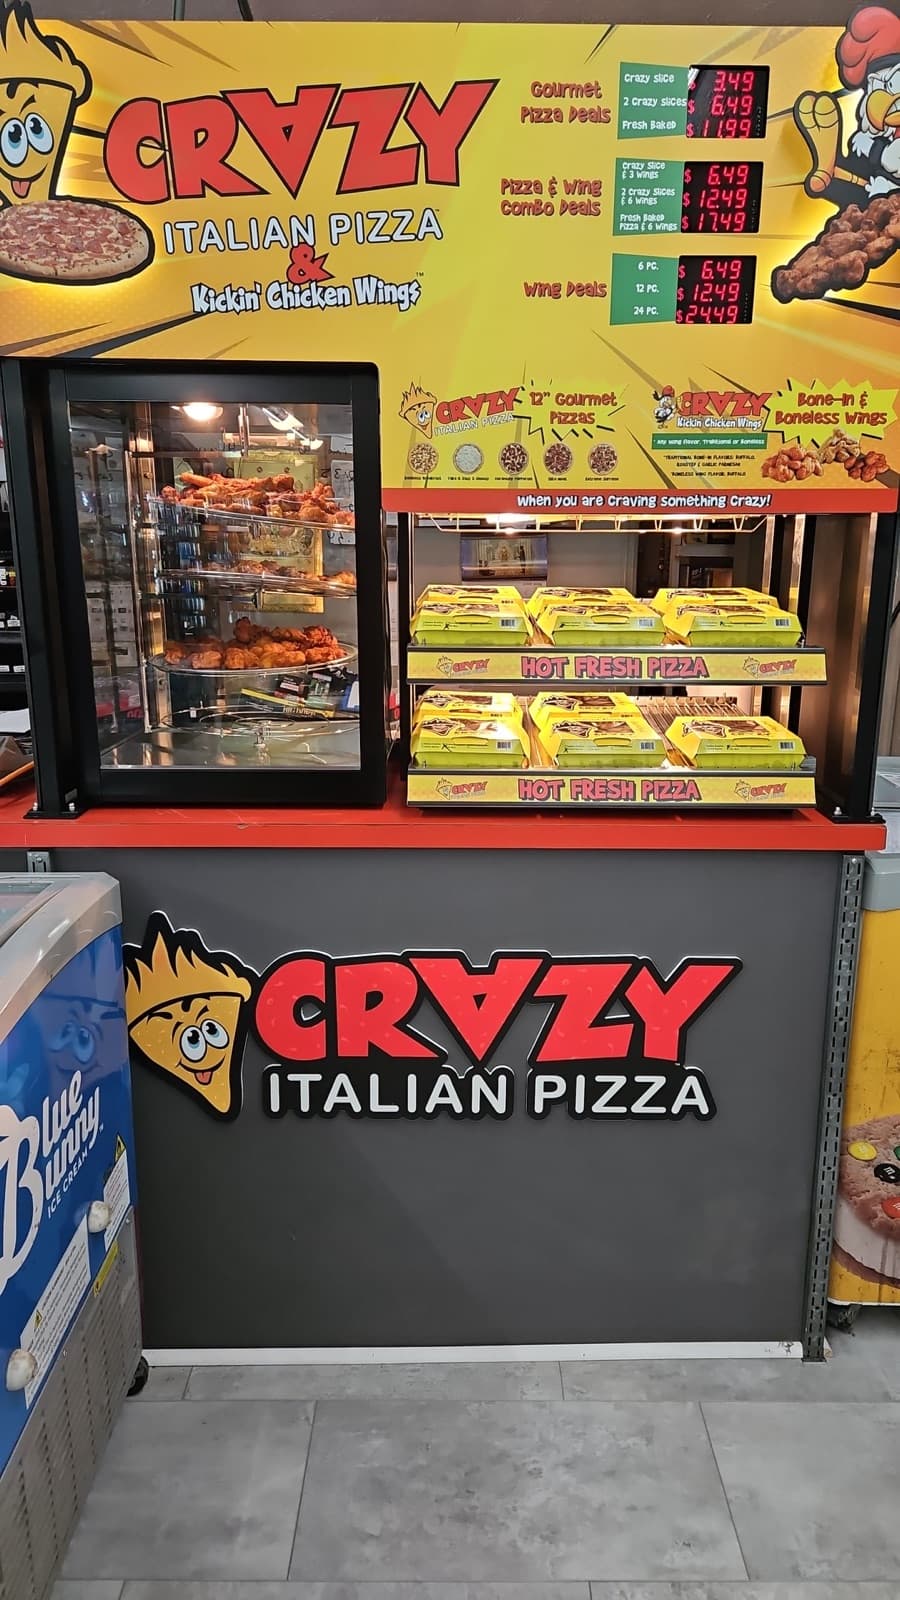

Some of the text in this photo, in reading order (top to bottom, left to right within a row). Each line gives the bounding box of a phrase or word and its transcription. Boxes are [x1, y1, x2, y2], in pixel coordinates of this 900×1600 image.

[531, 80, 603, 99] Gourmet
[713, 71, 754, 92] 3.49
[623, 97, 629, 106] 2
[711, 95, 753, 116] 6.49
[520, 105, 611, 124] Pizza Deals
[622, 120, 648, 130] Fresh
[103, 78, 501, 204] CRAZY
[629, 170, 634, 178] 3
[707, 165, 749, 185] 6.49
[501, 176, 602, 198] Pizza & Wing
[621, 188, 626, 196] 2
[559, 199, 601, 216] Deals
[620, 214, 641, 222] Fresh
[163, 208, 443, 254] ITALIAN PIZZA
[286, 242, 335, 284] &
[638, 261, 659, 271] 6 PC.
[701, 260, 742, 280] 6.49
[190, 274, 422, 315] Kickin' Chicken Wings
[524, 281, 607, 299] Wing Deals
[635, 284, 660, 293] 12 PC.
[634, 306, 659, 315] 24 PC.
[436, 387, 520, 424] CRAZY
[555, 392, 617, 406] Gourmet
[677, 391, 773, 416] CRAZY
[859, 391, 868, 409] &
[434, 413, 514, 436] ITALIAN PIZZA
[550, 411, 595, 424] Pizzas
[704, 416, 737, 428] Chicken
[738, 416, 762, 430] Wings
[775, 410, 840, 425] Boneless
[555, 495, 577, 508] you
[581, 495, 604, 506] are
[660, 494, 726, 508] something
[521, 656, 710, 679] HOT FRESH PIZZA
[518, 778, 703, 801] HOT FRESH PIZZA
[254, 956, 736, 1063] CRAZY
[268, 1074, 710, 1114] ITALIAN PIZZA
[47, 1149, 88, 1220] ICE CREAM
